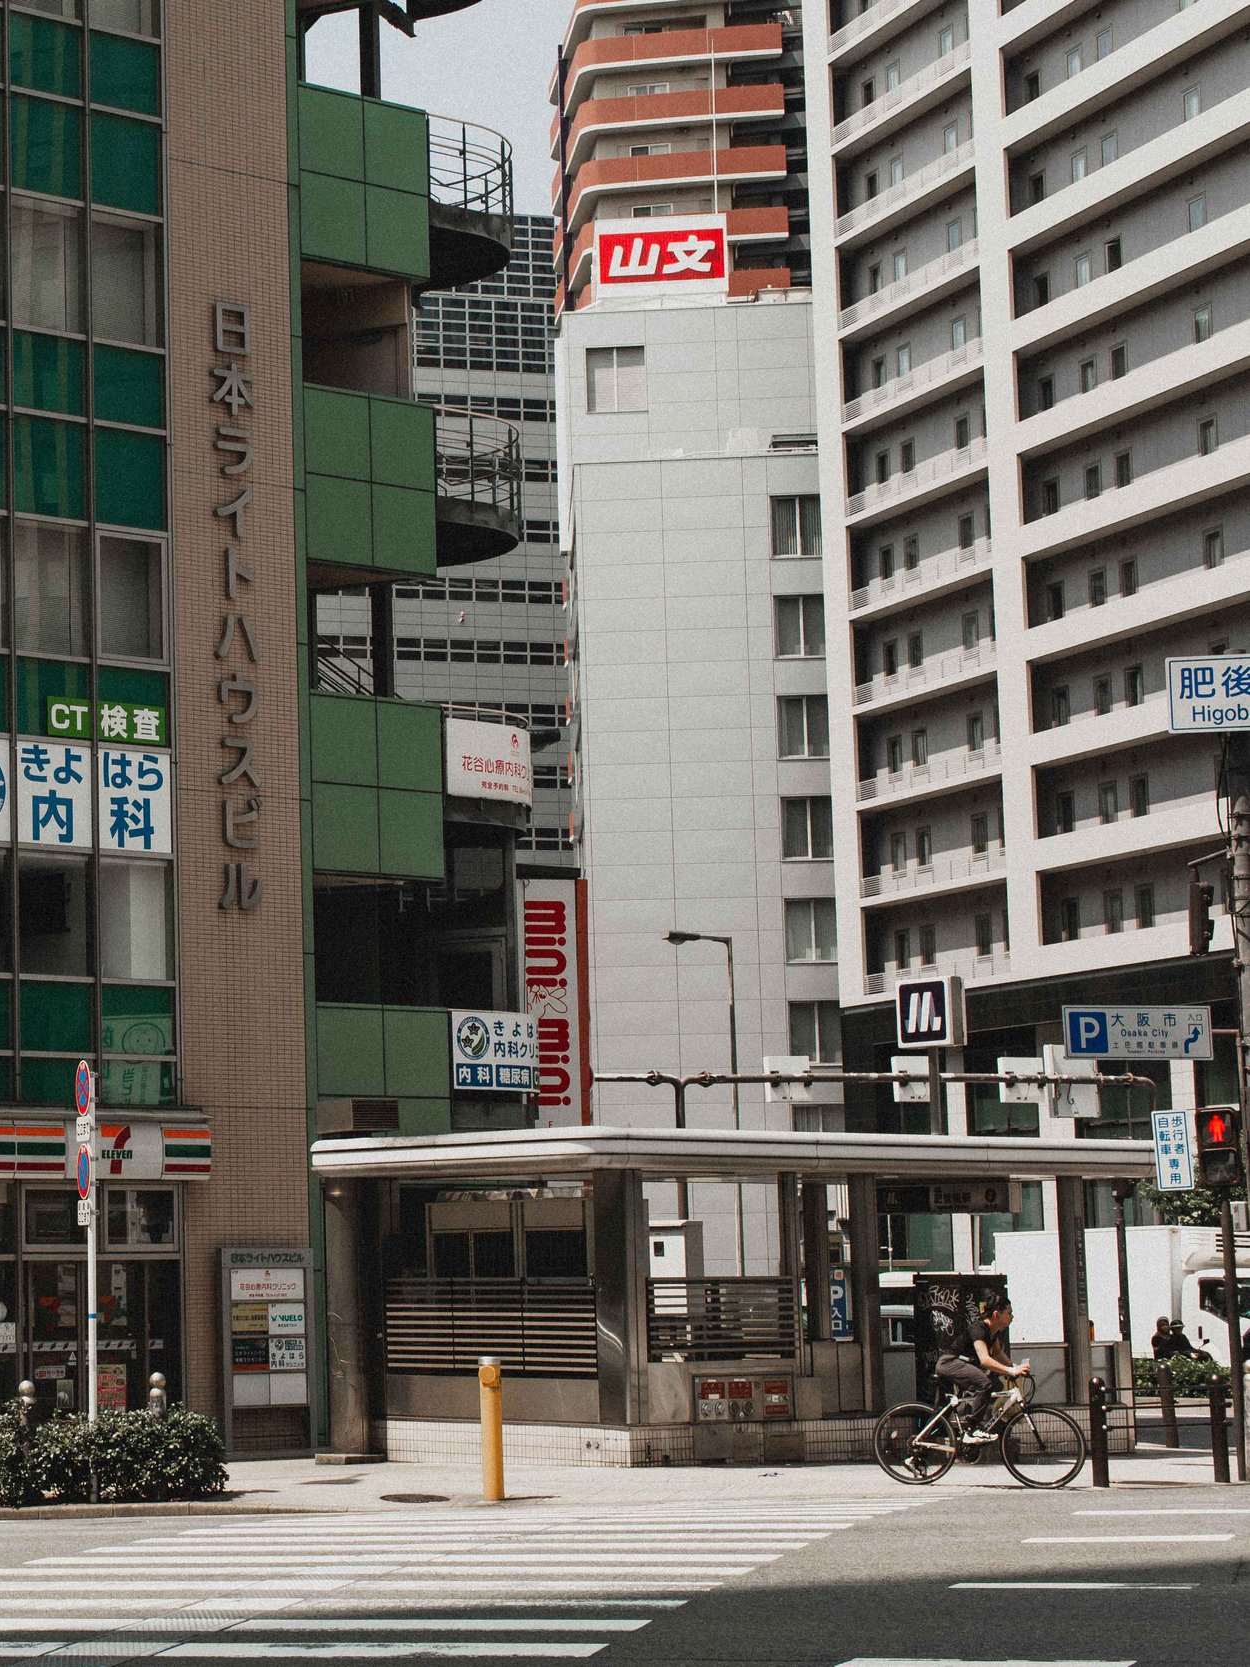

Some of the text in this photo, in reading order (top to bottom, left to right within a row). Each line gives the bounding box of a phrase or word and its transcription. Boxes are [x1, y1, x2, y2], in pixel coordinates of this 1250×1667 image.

[608, 235, 715, 277] 山文
[210, 301, 261, 909] 日本ライトハウスビル
[51, 703, 160, 741] CT検査
[1192, 703, 1249, 725] Higob
[20, 744, 164, 792] きよはら
[32, 789, 155, 850] 内科
[494, 1020, 538, 1039] きよは
[1079, 1016, 1100, 1049] P
[1111, 1012, 1177, 1028] 大阪市
[1120, 1028, 1169, 1038] Osaka City
[458, 1066, 491, 1084] 内科
[499, 1067, 530, 1086] 糖尿病
[1158, 1116, 1171, 1155] 自転車
[1171, 1116, 1184, 1155] 歩行者
